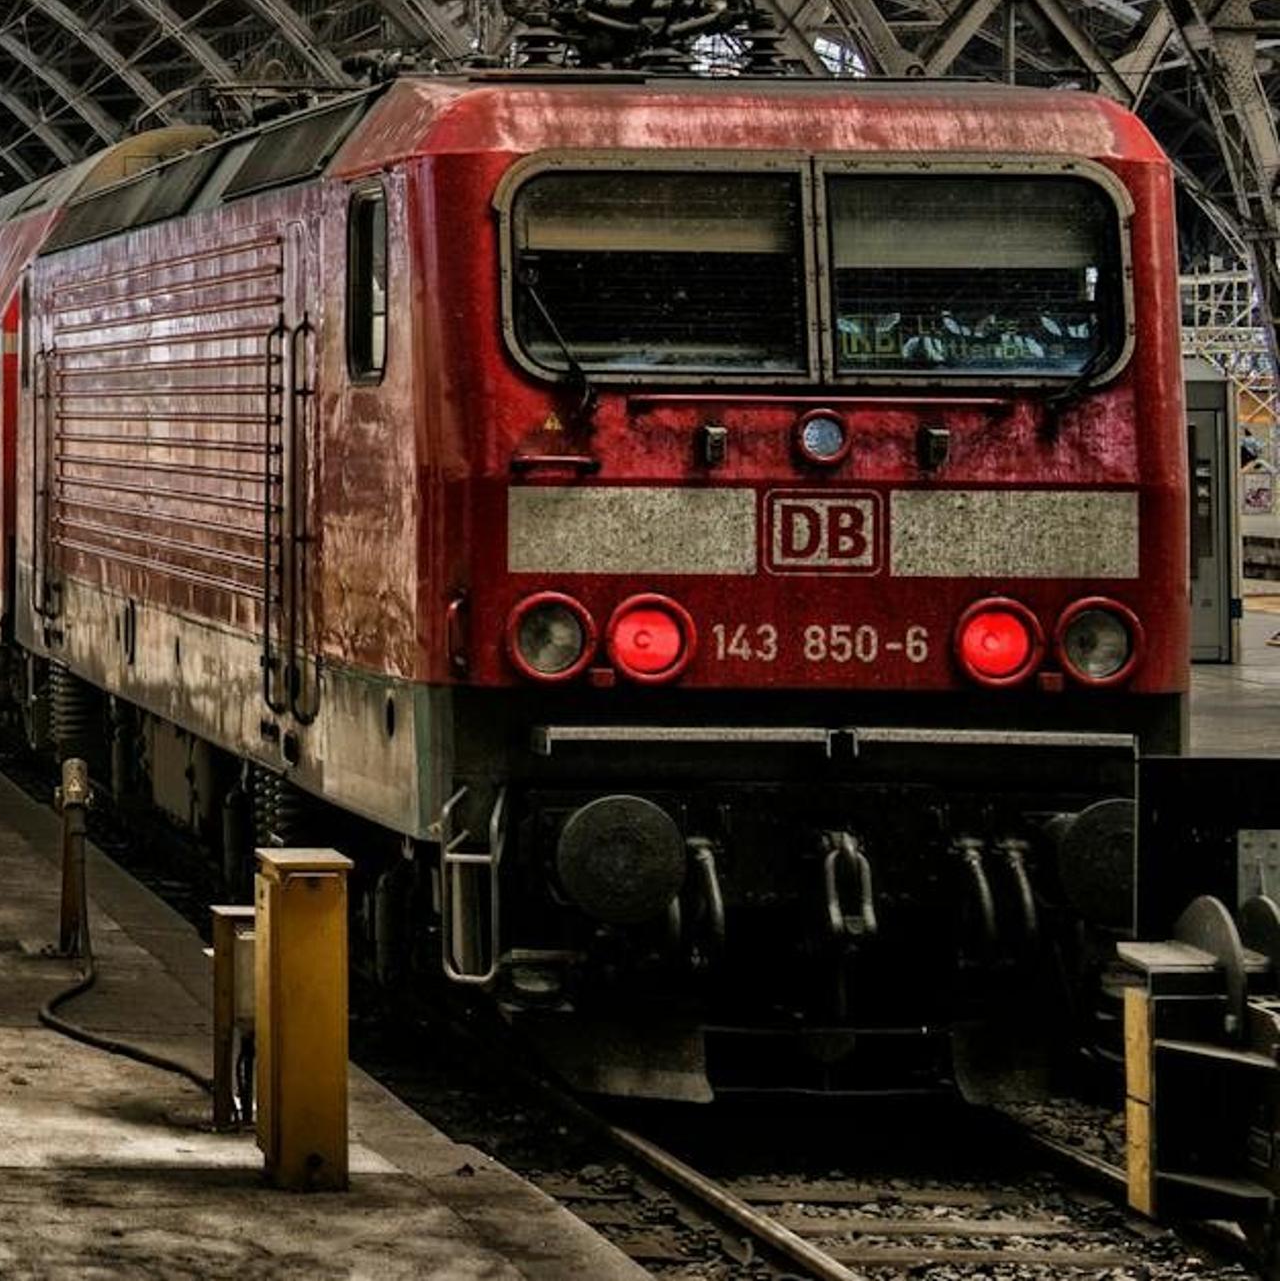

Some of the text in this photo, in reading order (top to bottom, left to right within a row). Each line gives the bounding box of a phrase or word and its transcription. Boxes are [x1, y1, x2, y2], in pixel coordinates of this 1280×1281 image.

[780, 504, 868, 560] DB
[712, 623, 929, 663] 143 850-6
